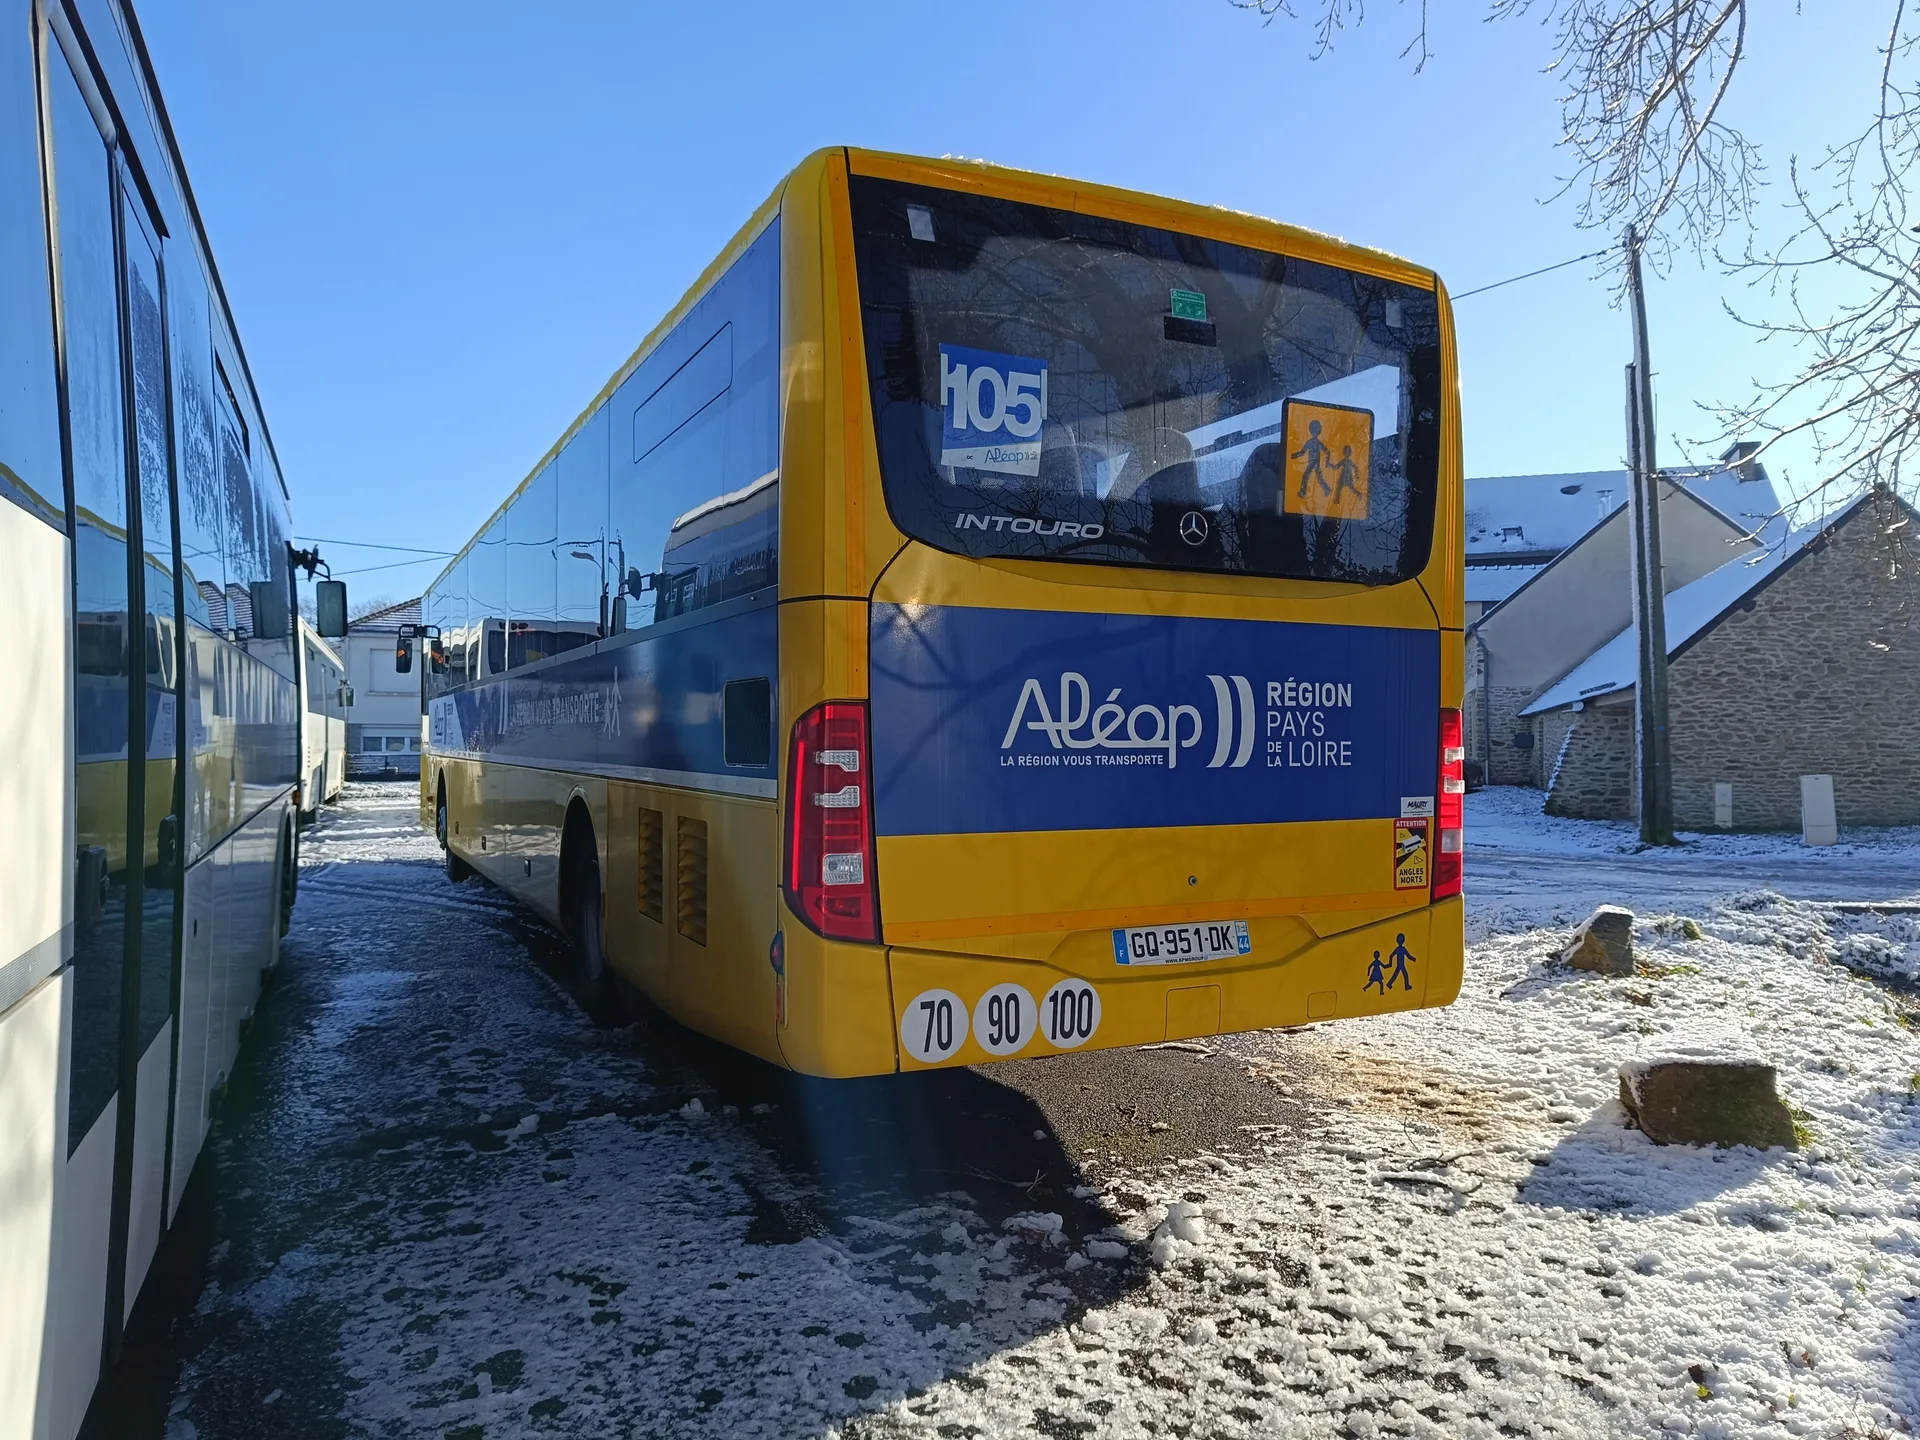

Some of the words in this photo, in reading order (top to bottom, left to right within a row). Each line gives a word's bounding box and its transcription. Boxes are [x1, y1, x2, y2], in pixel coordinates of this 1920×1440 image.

[947, 363, 1043, 438] 105
[984, 447, 1024, 465] Aléop
[954, 513, 1104, 539] INTOURO
[1267, 677, 1352, 707] RÉGION
[552, 692, 599, 724] TRANSPORTE
[1001, 671, 1203, 769] Aléop
[1267, 711, 1325, 737] PAYS
[1000, 755, 1015, 766] LA
[1018, 753, 1059, 766] RÉGION
[1062, 755, 1092, 766] VOUS
[1094, 754, 1164, 766] TRANSPORTE
[1267, 741, 1282, 753] DE
[1267, 755, 1282, 767] LA
[1289, 741, 1352, 767] LOIRE
[1396, 820, 1427, 828] ATTENTION
[1399, 868, 1424, 876] ANGLES
[1400, 876, 1423, 884] MORTS
[1118, 949, 1124, 958] F
[1130, 925, 1234, 958] GQ-951-DK
[1238, 939, 1250, 950] 44
[920, 998, 953, 1053] 70
[988, 992, 1020, 1046] 90
[1049, 988, 1094, 1040] 100
